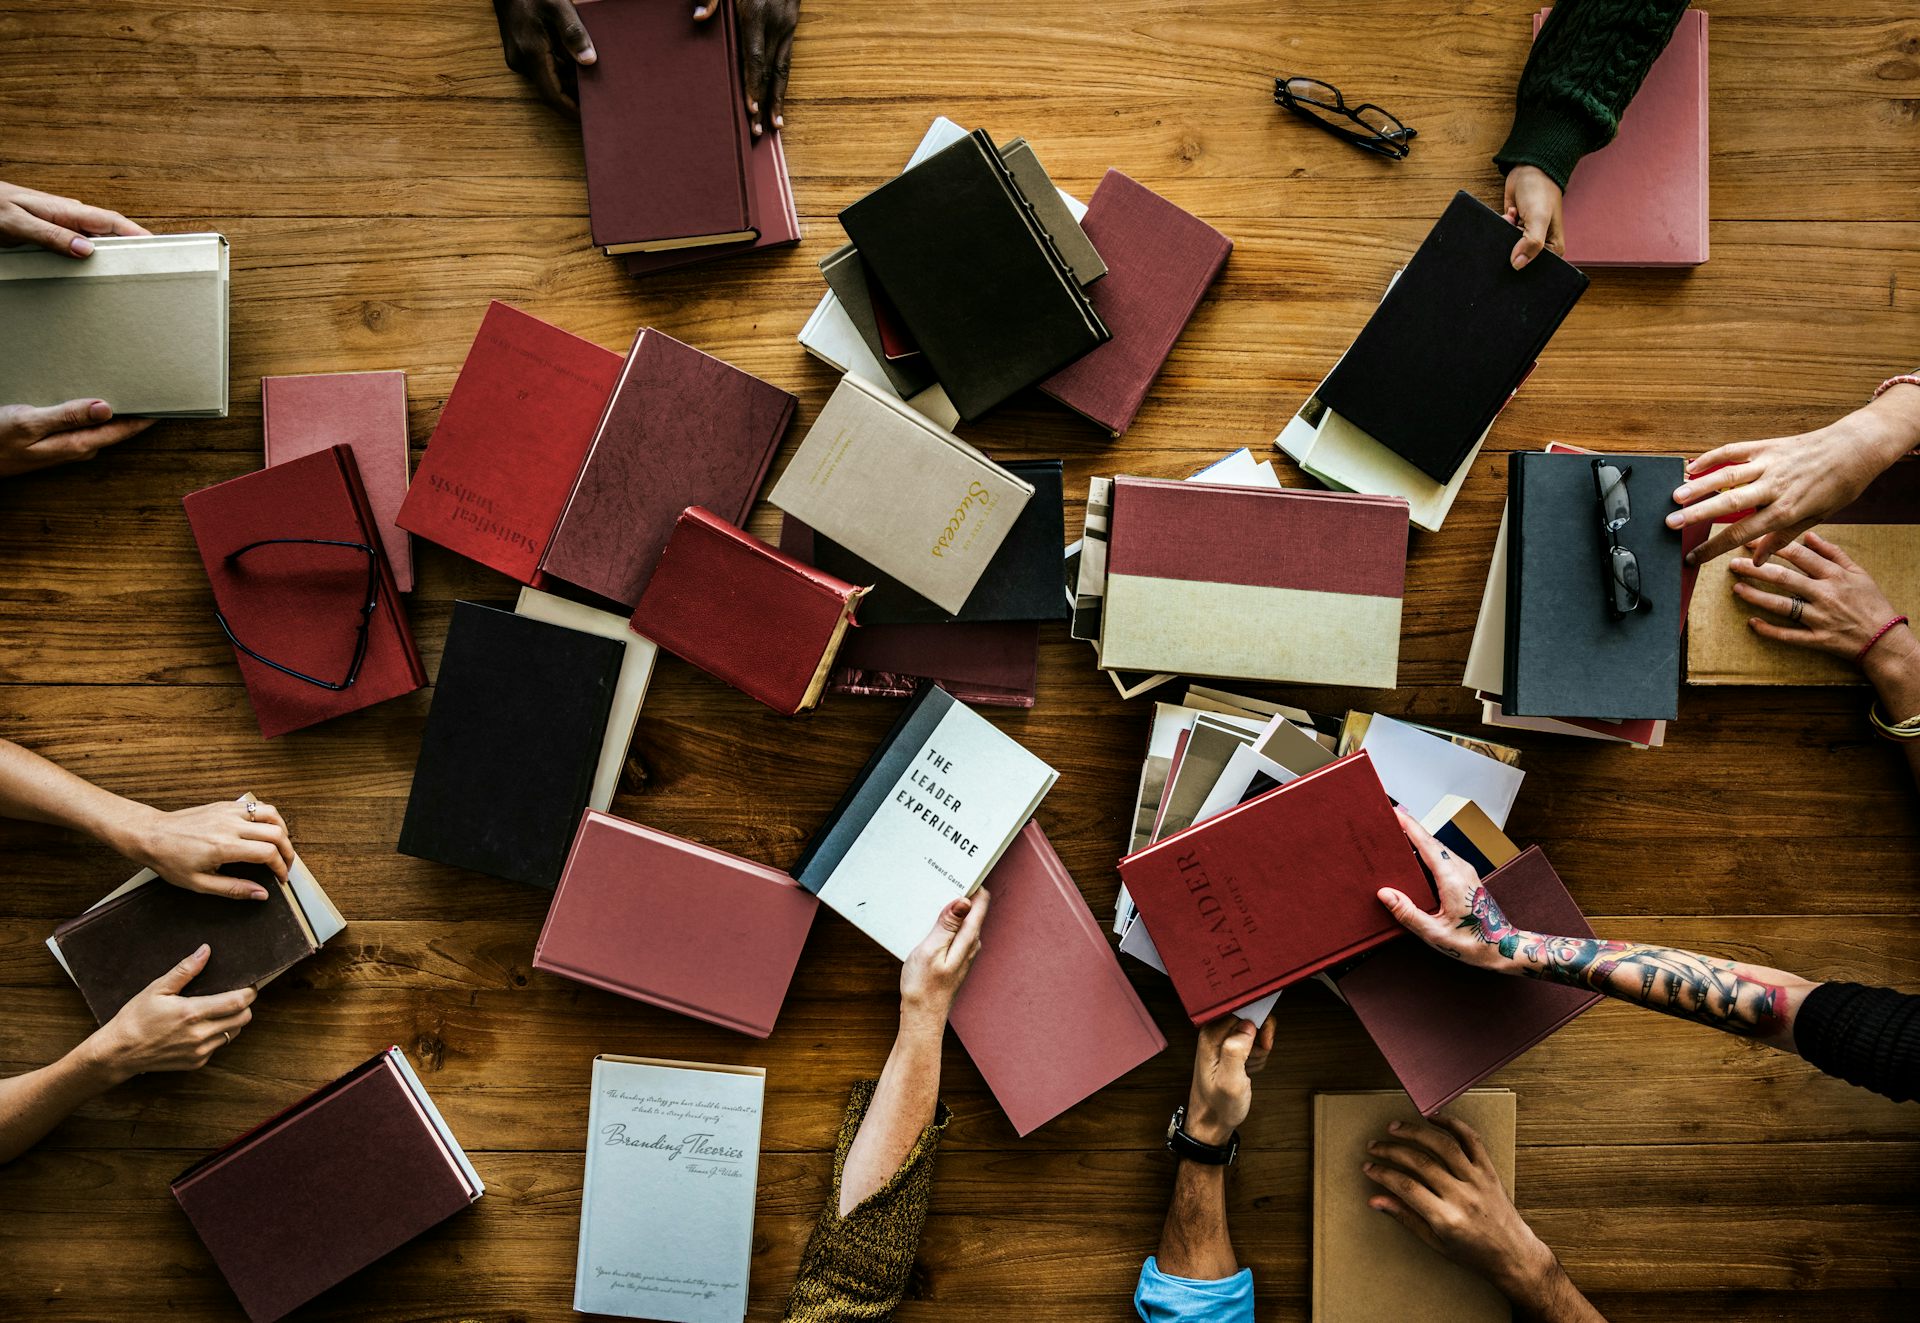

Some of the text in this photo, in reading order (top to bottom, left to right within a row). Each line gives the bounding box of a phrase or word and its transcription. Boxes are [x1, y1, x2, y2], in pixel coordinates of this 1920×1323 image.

[429, 474, 500, 514] Analysis
[452, 507, 537, 554] Statistical
[932, 481, 989, 557] Success
[926, 749, 953, 774] THE
[910, 769, 962, 813] LEADER
[896, 789, 979, 858] EXPERIENCE
[927, 858, 948, 876] Edward
[948, 874, 965, 890] Carter
[1177, 849, 1251, 979] LEADER
[1224, 876, 1257, 934] theory
[1201, 958, 1221, 989] The
[619, 1092, 645, 1104] branding
[646, 1096, 668, 1107] strategy
[601, 1123, 743, 1161] Branding Theories
